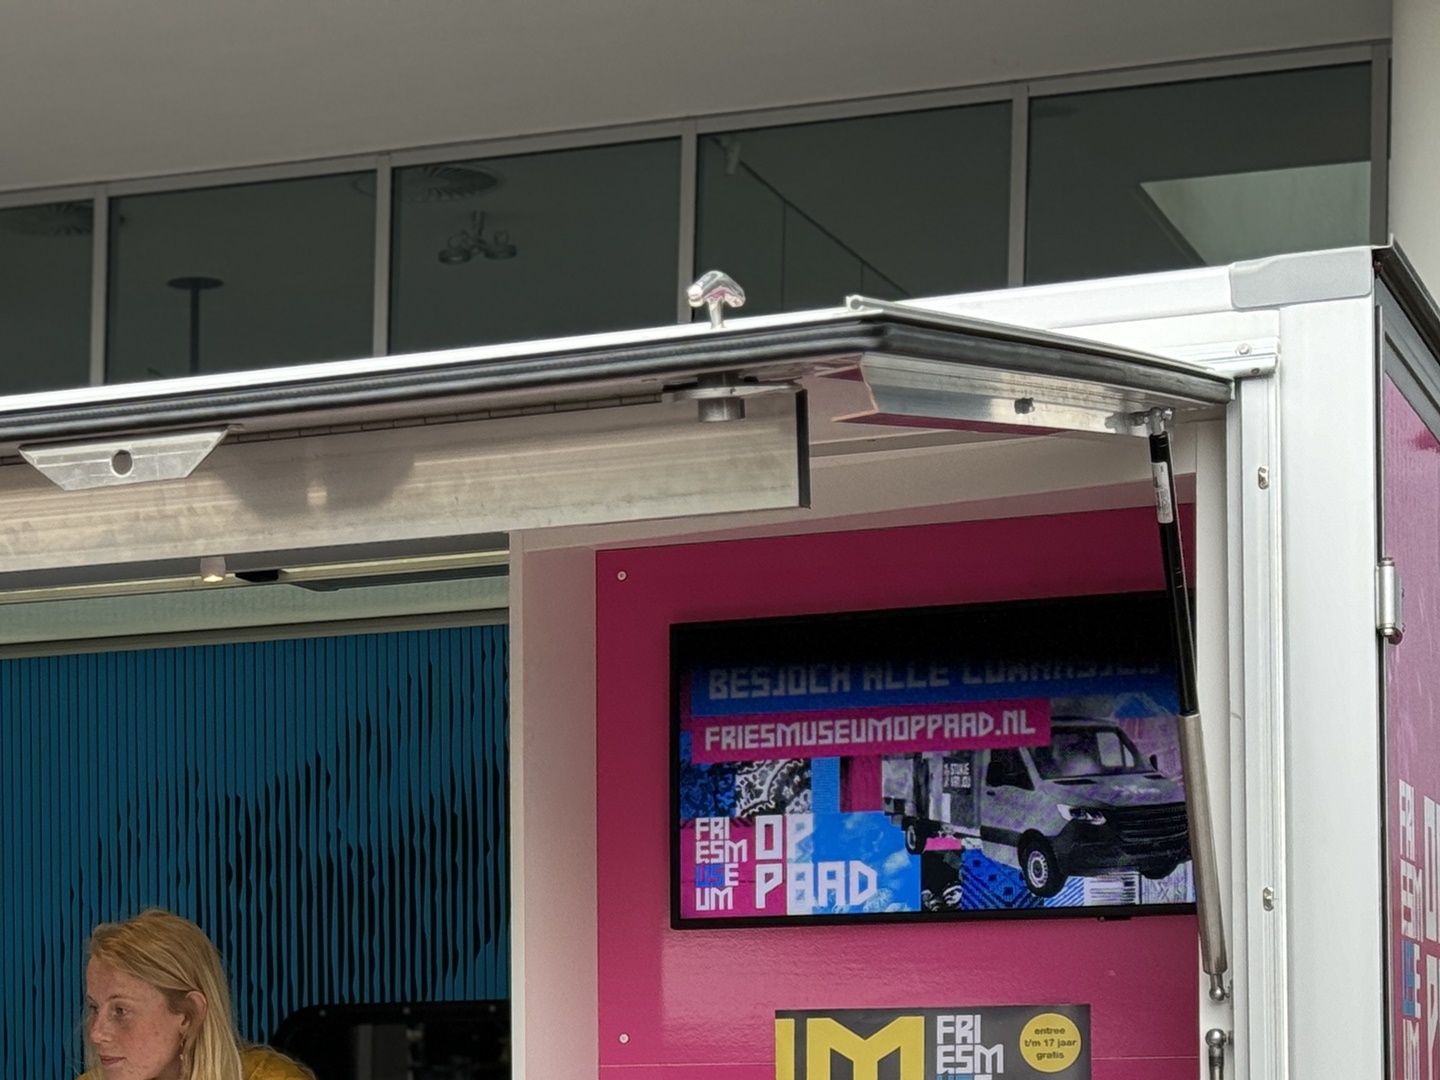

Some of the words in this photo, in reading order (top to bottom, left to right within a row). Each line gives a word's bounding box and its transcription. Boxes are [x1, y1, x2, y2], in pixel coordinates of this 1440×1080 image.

[705, 709, 1037, 751] FRIESMUSEUMOPPAAD.NL
[696, 816, 730, 840] FRI
[755, 814, 814, 861] OP
[696, 863, 739, 888] USE
[755, 860, 878, 910] PAAD
[696, 887, 734, 911] UM
[937, 1014, 981, 1044] FRI
[1034, 1027, 1066, 1036] entree
[1024, 1039, 1041, 1048] t/m
[1044, 1039, 1055, 1048] 17
[1057, 1039, 1077, 1050] jaar
[1036, 1051, 1065, 1061] gratis
[937, 1044, 1004, 1074] ESM
